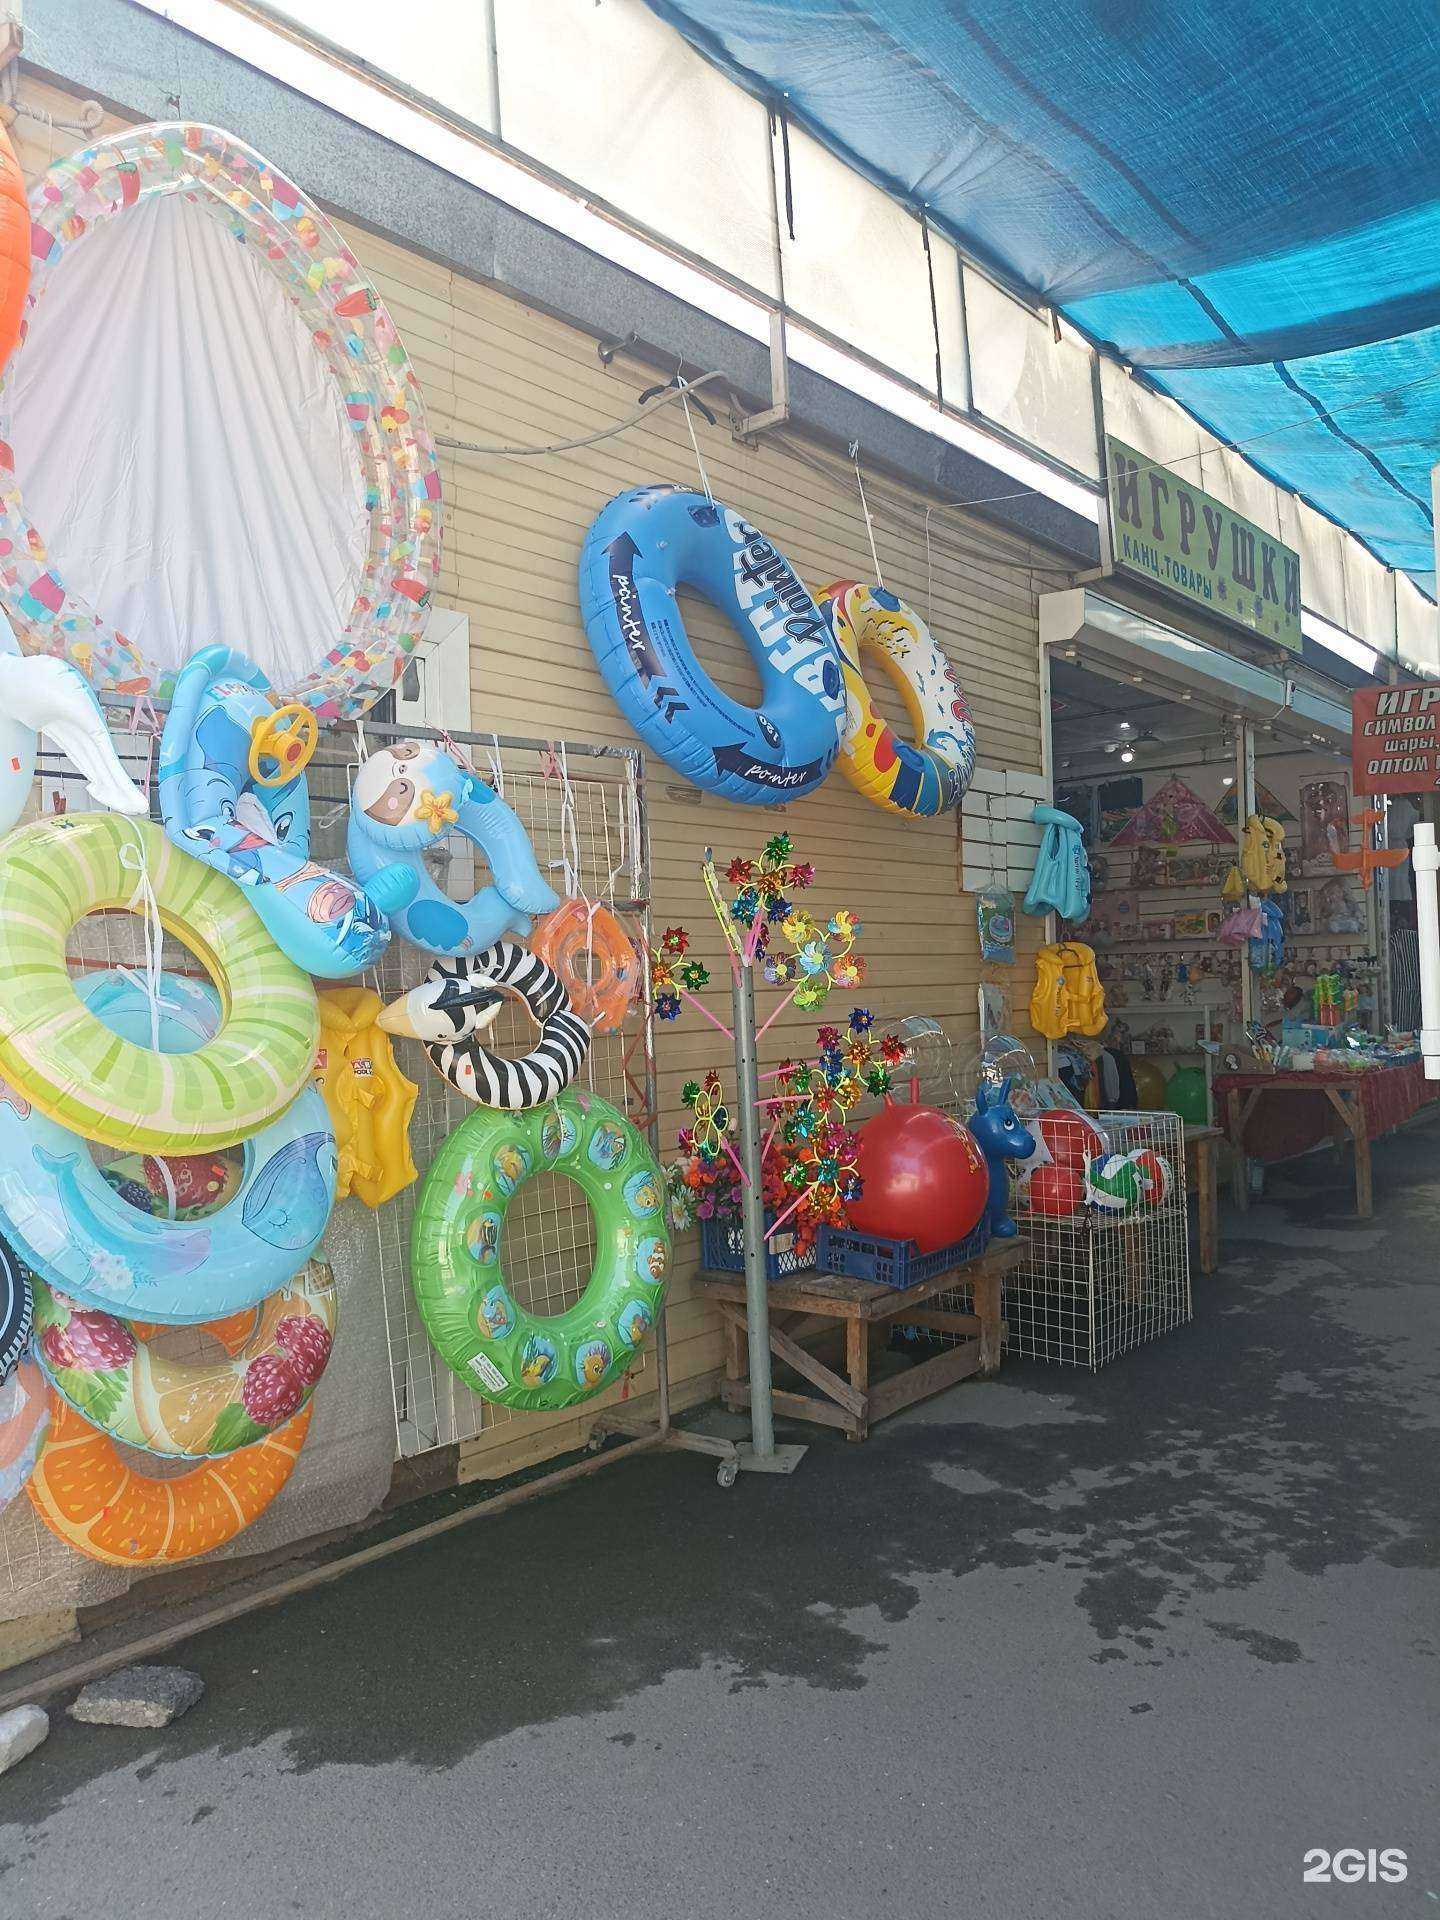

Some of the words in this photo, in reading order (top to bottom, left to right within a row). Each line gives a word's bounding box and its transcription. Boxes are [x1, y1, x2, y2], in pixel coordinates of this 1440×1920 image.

[1114, 452, 1299, 617] ИГРУШКИ
[1123, 533, 1213, 601] КАНЦ.ТОВАРЫ
[612, 574, 646, 651] pointer
[759, 713, 780, 742] 120
[1364, 715, 1436, 736] СИМВОЛ
[744, 763, 807, 787] pointer
